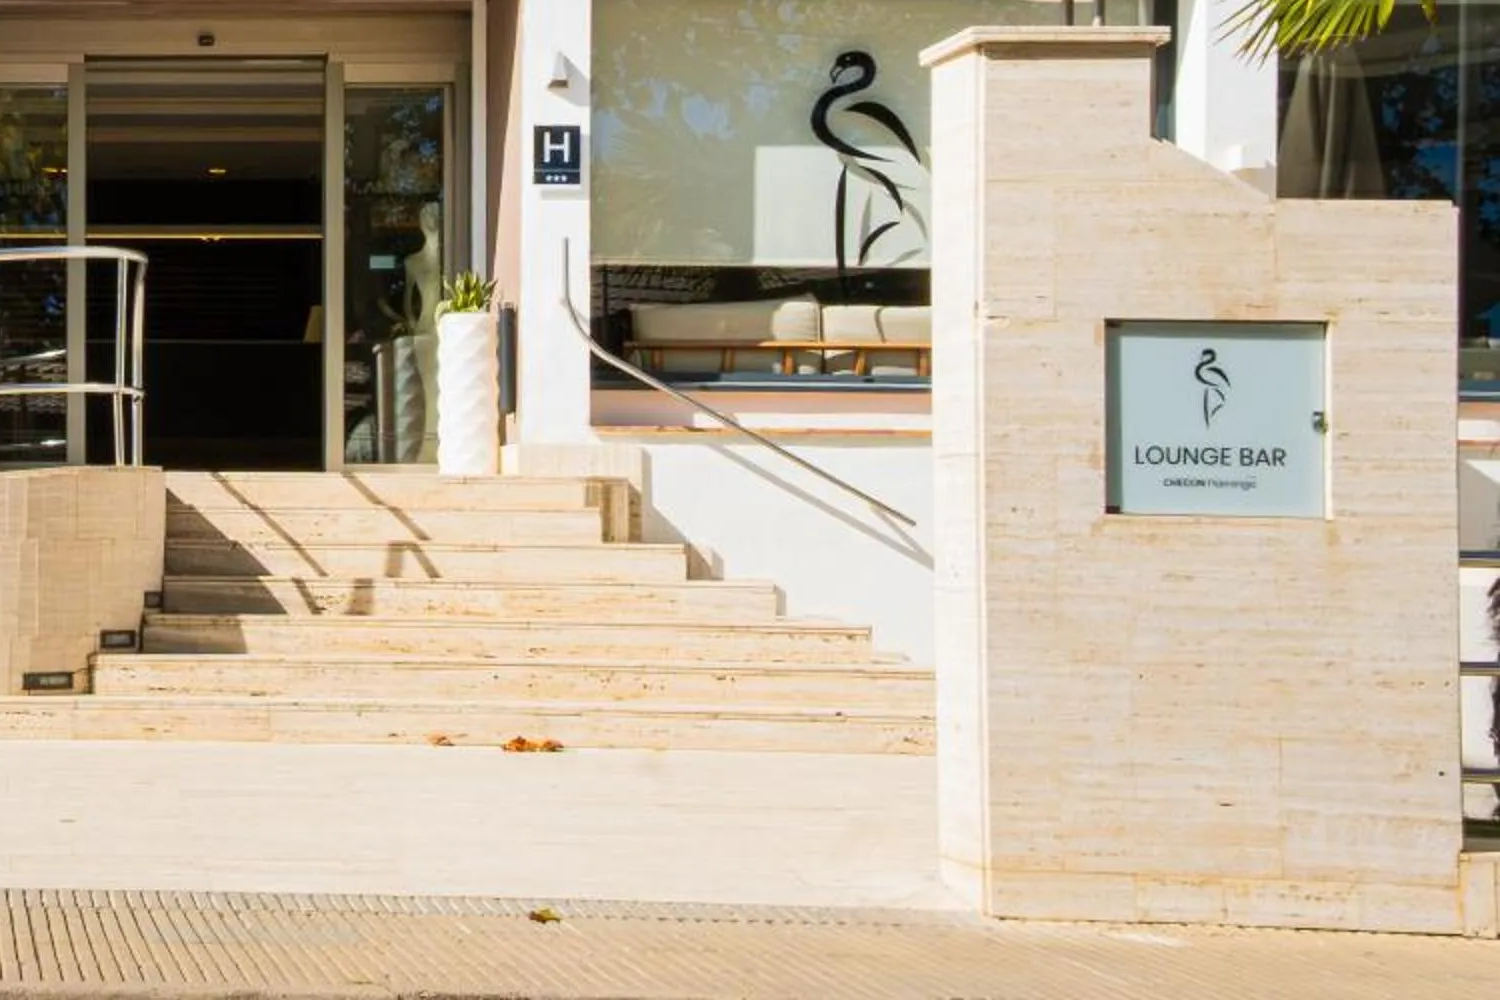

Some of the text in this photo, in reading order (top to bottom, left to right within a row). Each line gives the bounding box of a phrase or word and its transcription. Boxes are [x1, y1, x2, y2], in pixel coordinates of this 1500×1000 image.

[543, 131, 570, 163] H
[1134, 446, 1287, 466] LOUNGE BAR
